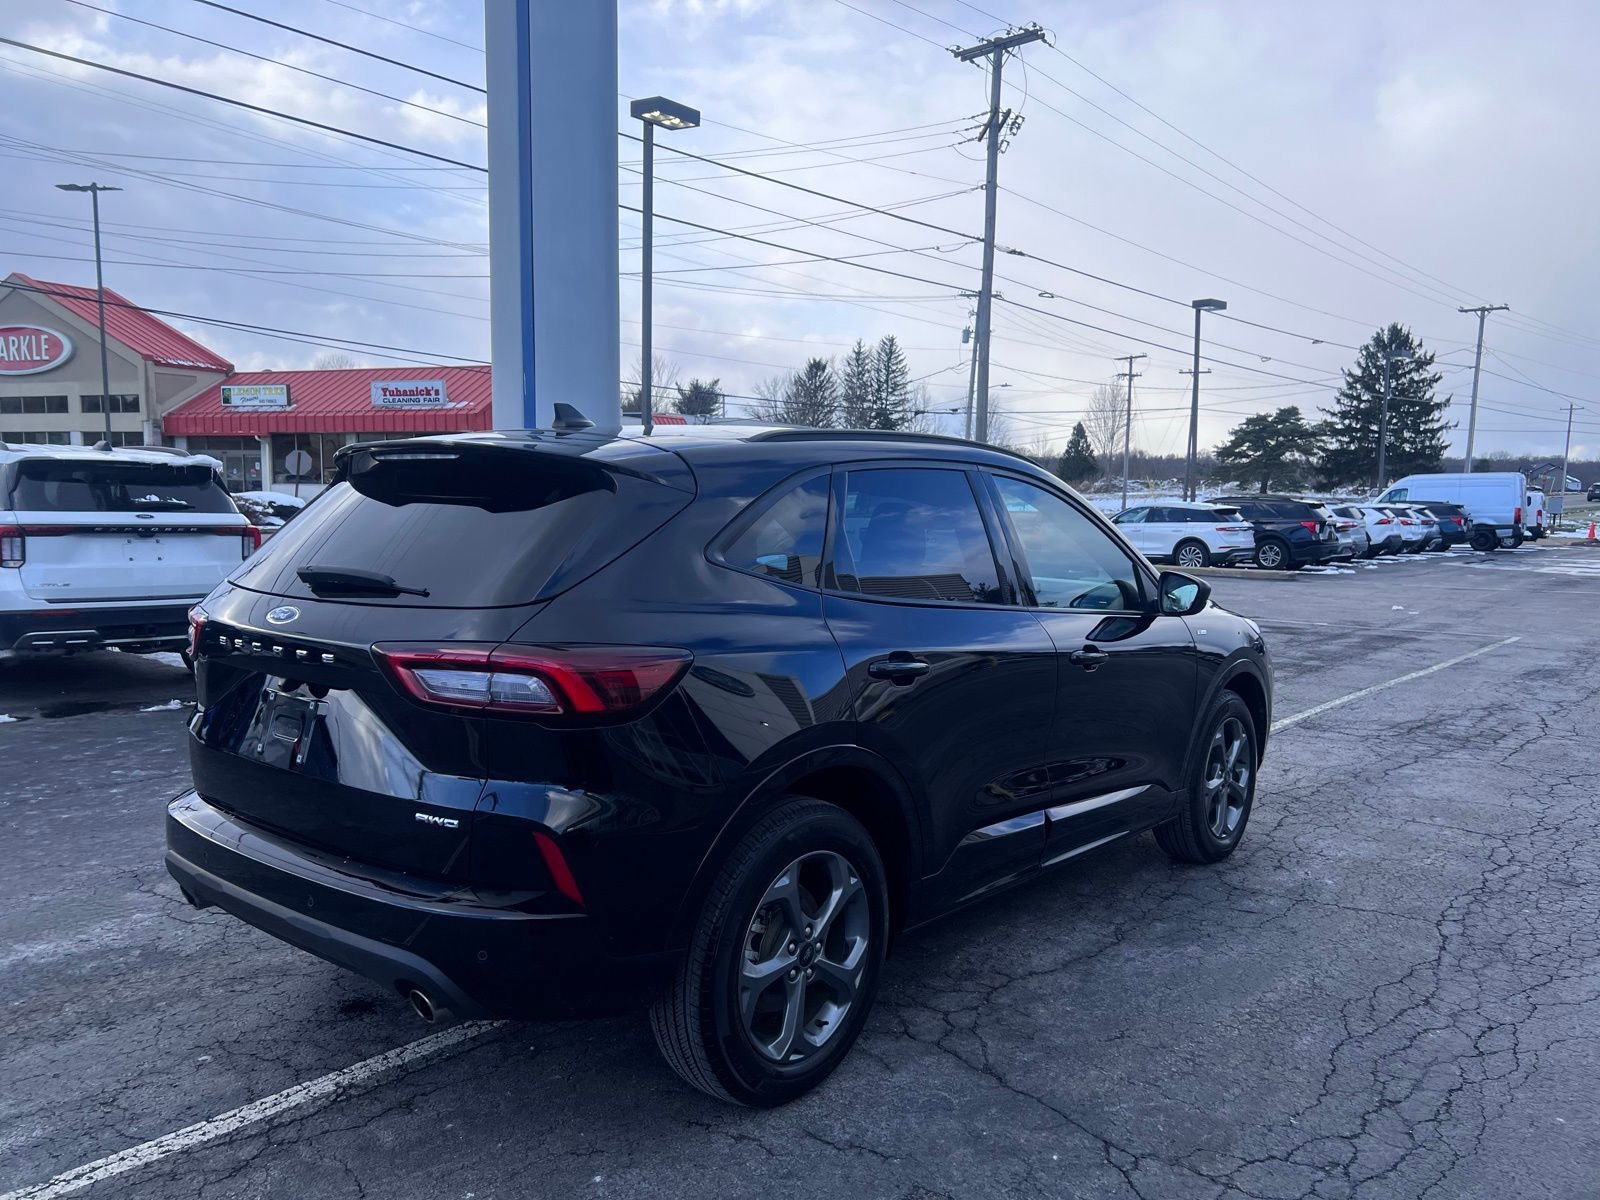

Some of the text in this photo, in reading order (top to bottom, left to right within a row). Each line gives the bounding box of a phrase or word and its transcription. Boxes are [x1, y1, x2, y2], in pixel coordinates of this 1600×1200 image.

[0, 335, 49, 361] ARKLE
[381, 386, 440, 397] Yuhanick's
[415, 813, 459, 828] AWD
